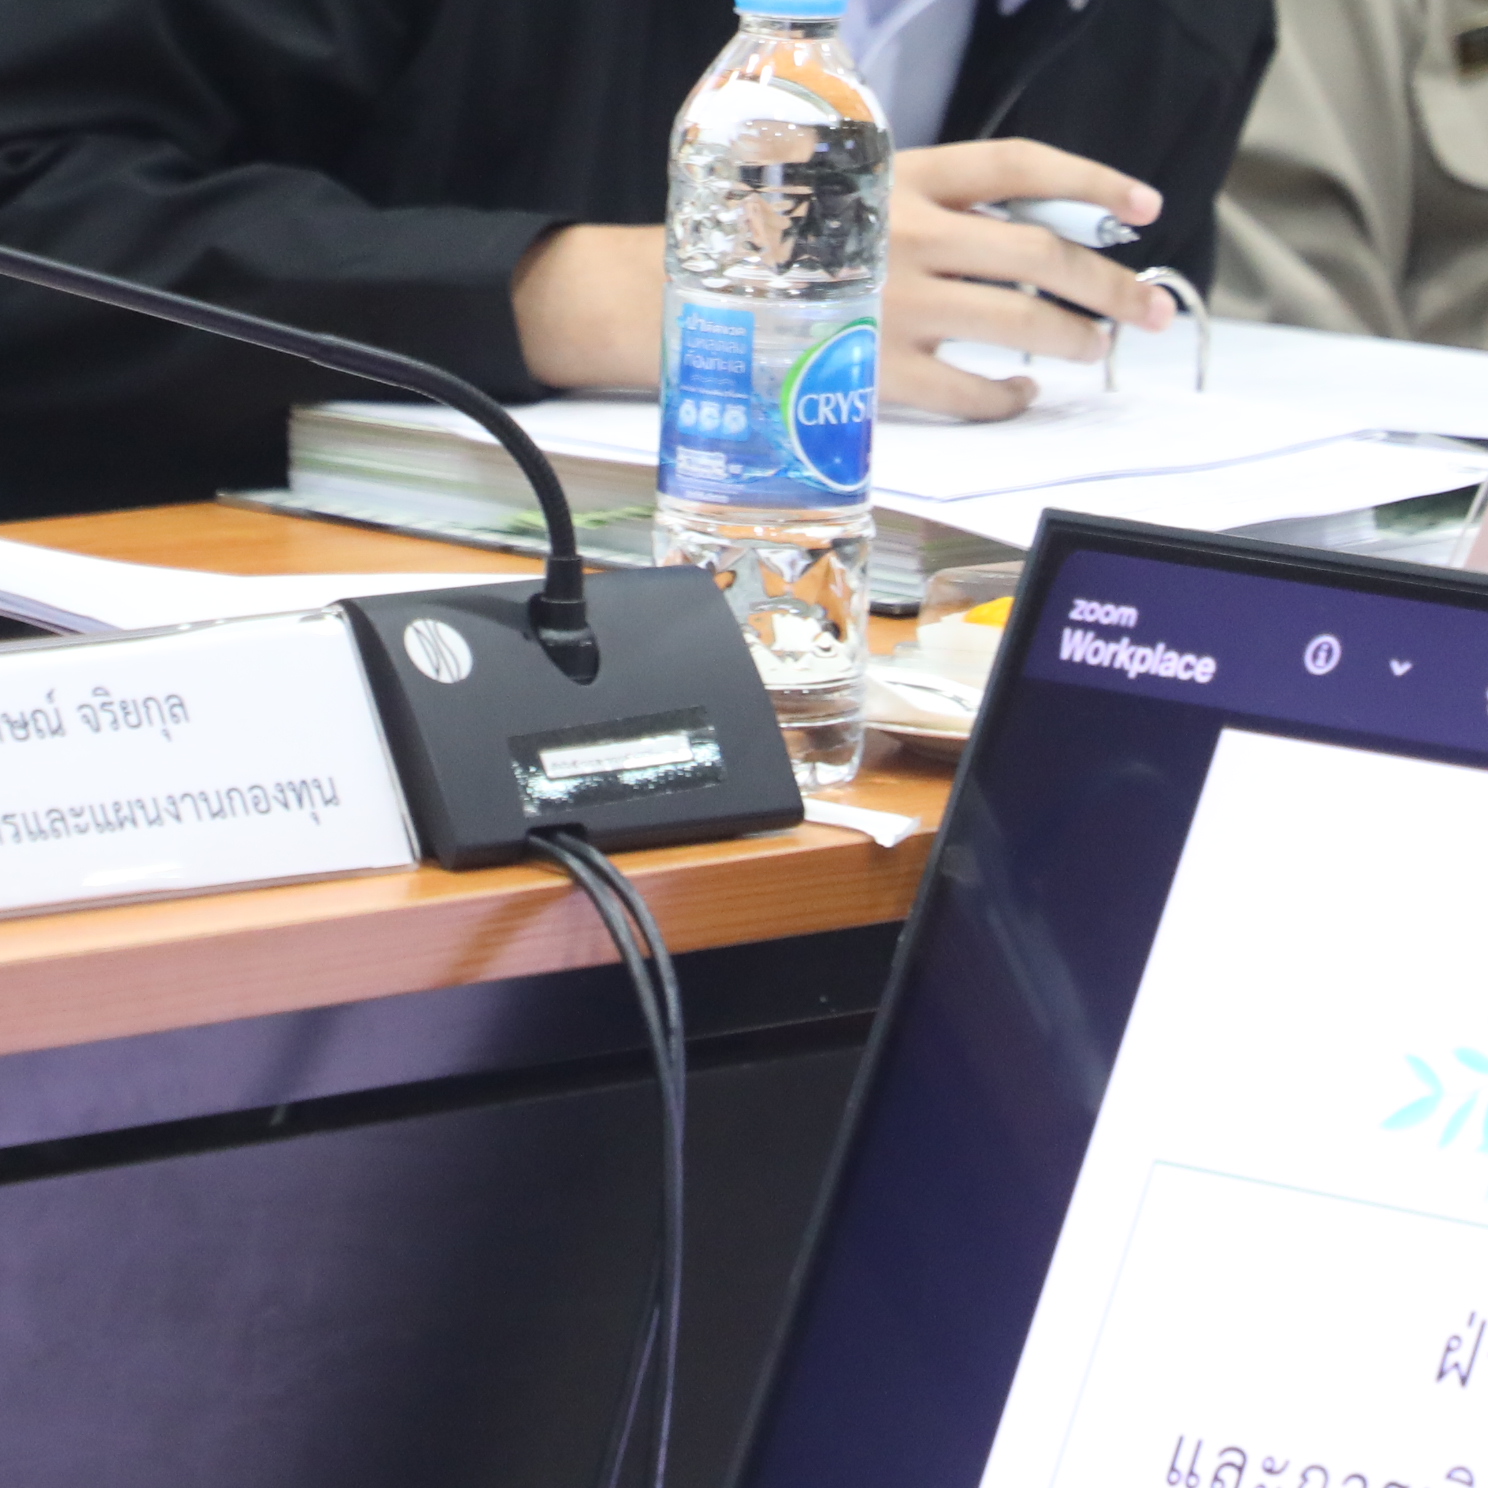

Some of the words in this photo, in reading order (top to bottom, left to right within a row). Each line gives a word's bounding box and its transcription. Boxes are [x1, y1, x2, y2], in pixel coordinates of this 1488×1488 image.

[1068, 597, 1139, 628] zoom
[1058, 626, 1217, 685] Workplace
[78, 686, 191, 751] จริยกุล
